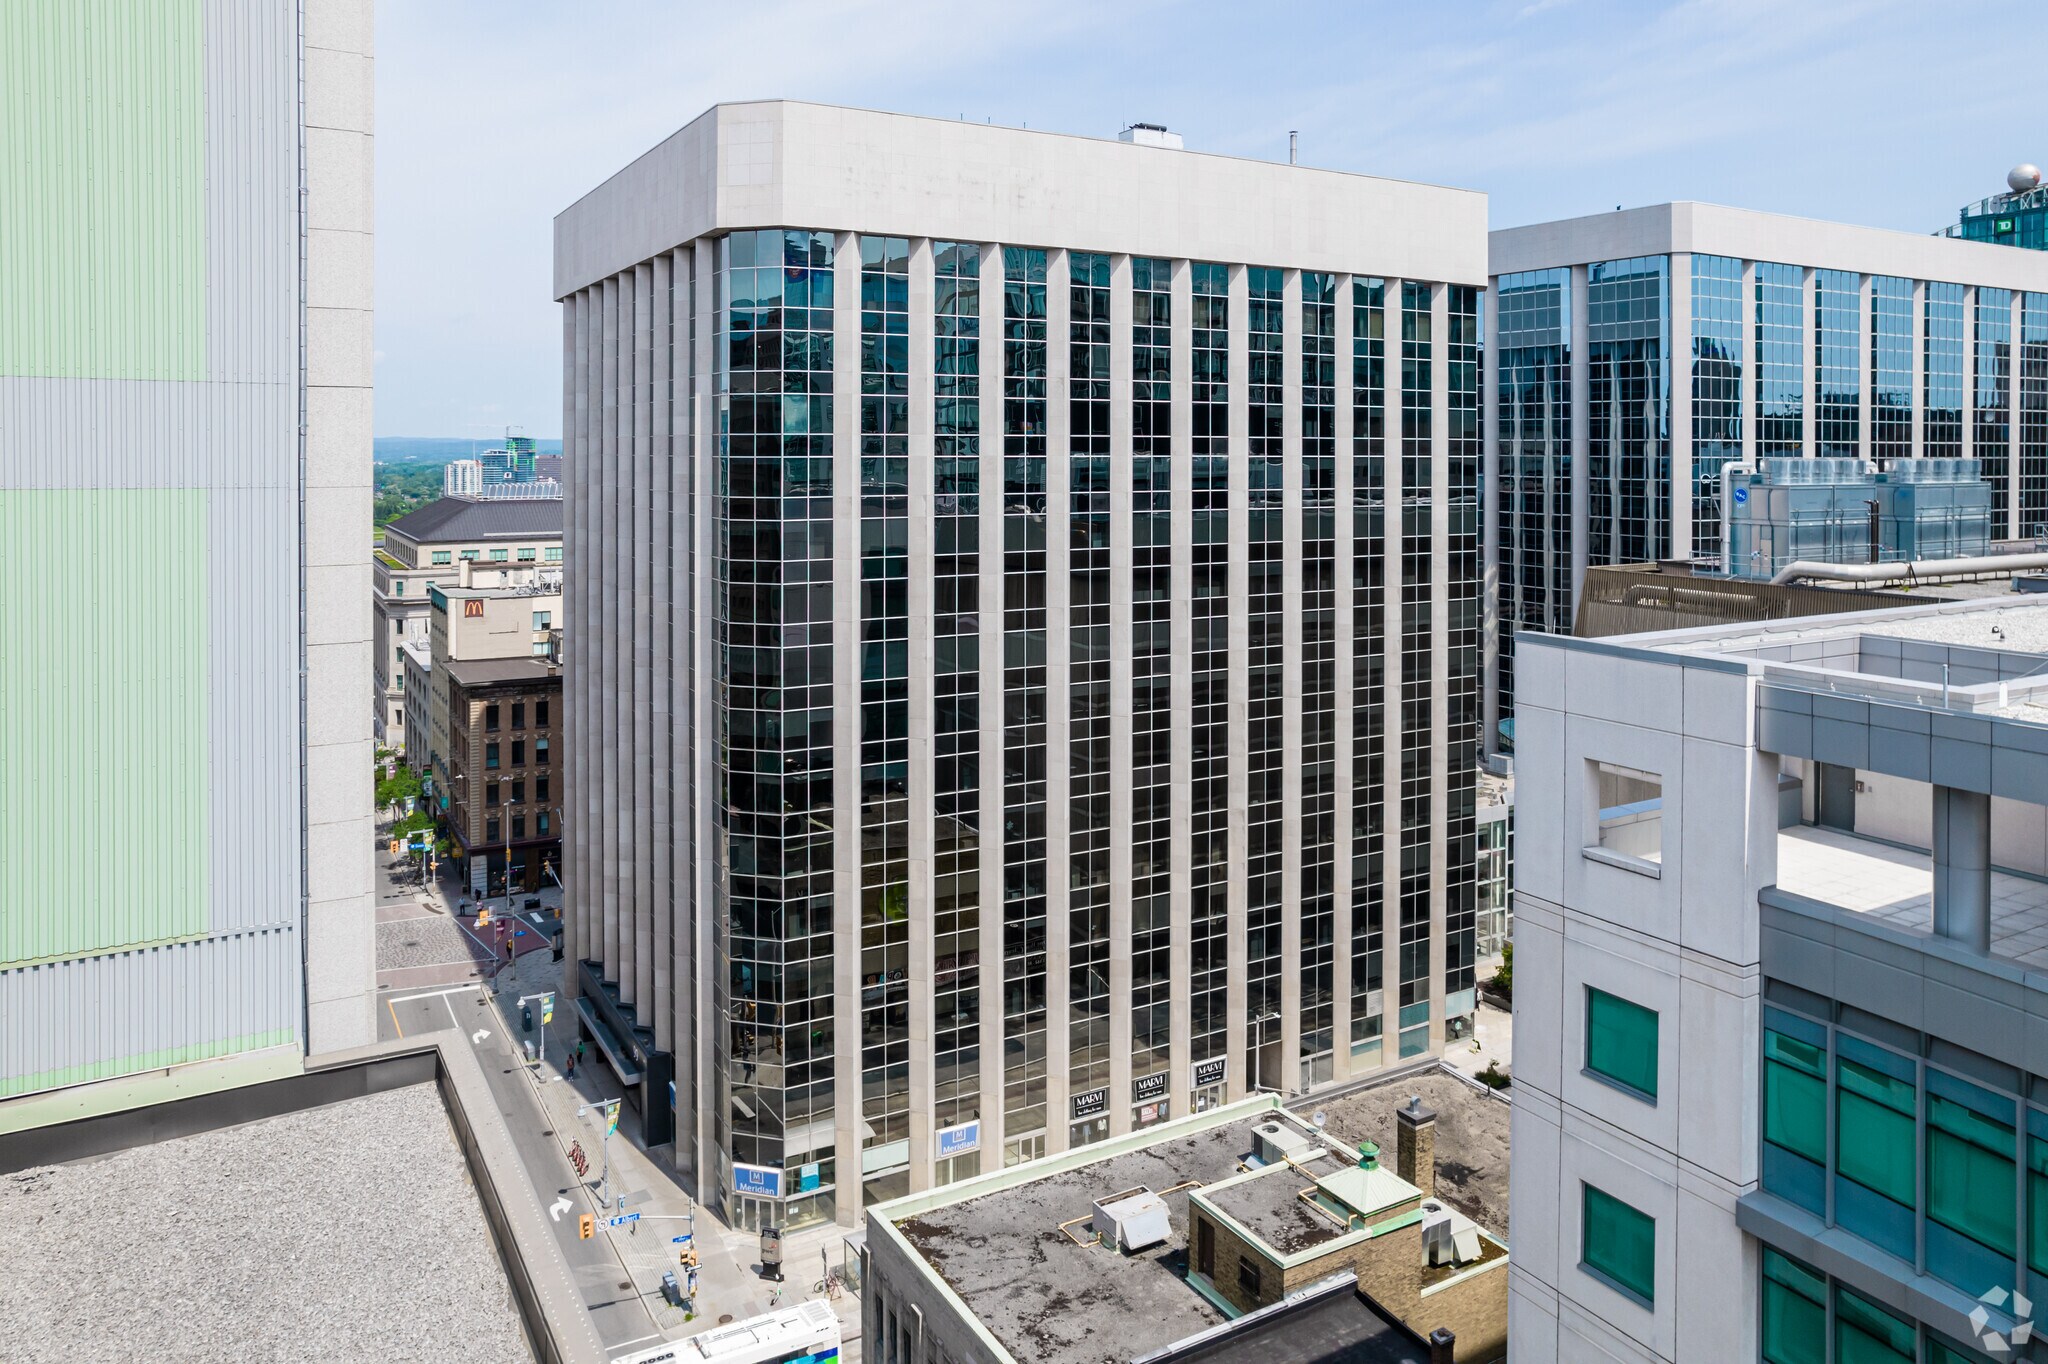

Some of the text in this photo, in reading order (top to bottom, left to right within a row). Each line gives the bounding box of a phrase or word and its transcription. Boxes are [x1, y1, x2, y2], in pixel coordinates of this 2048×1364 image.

[1998, 221, 2011, 230] TD
[943, 1140, 976, 1154] Meridian
[739, 1183, 775, 1195] Meridian
